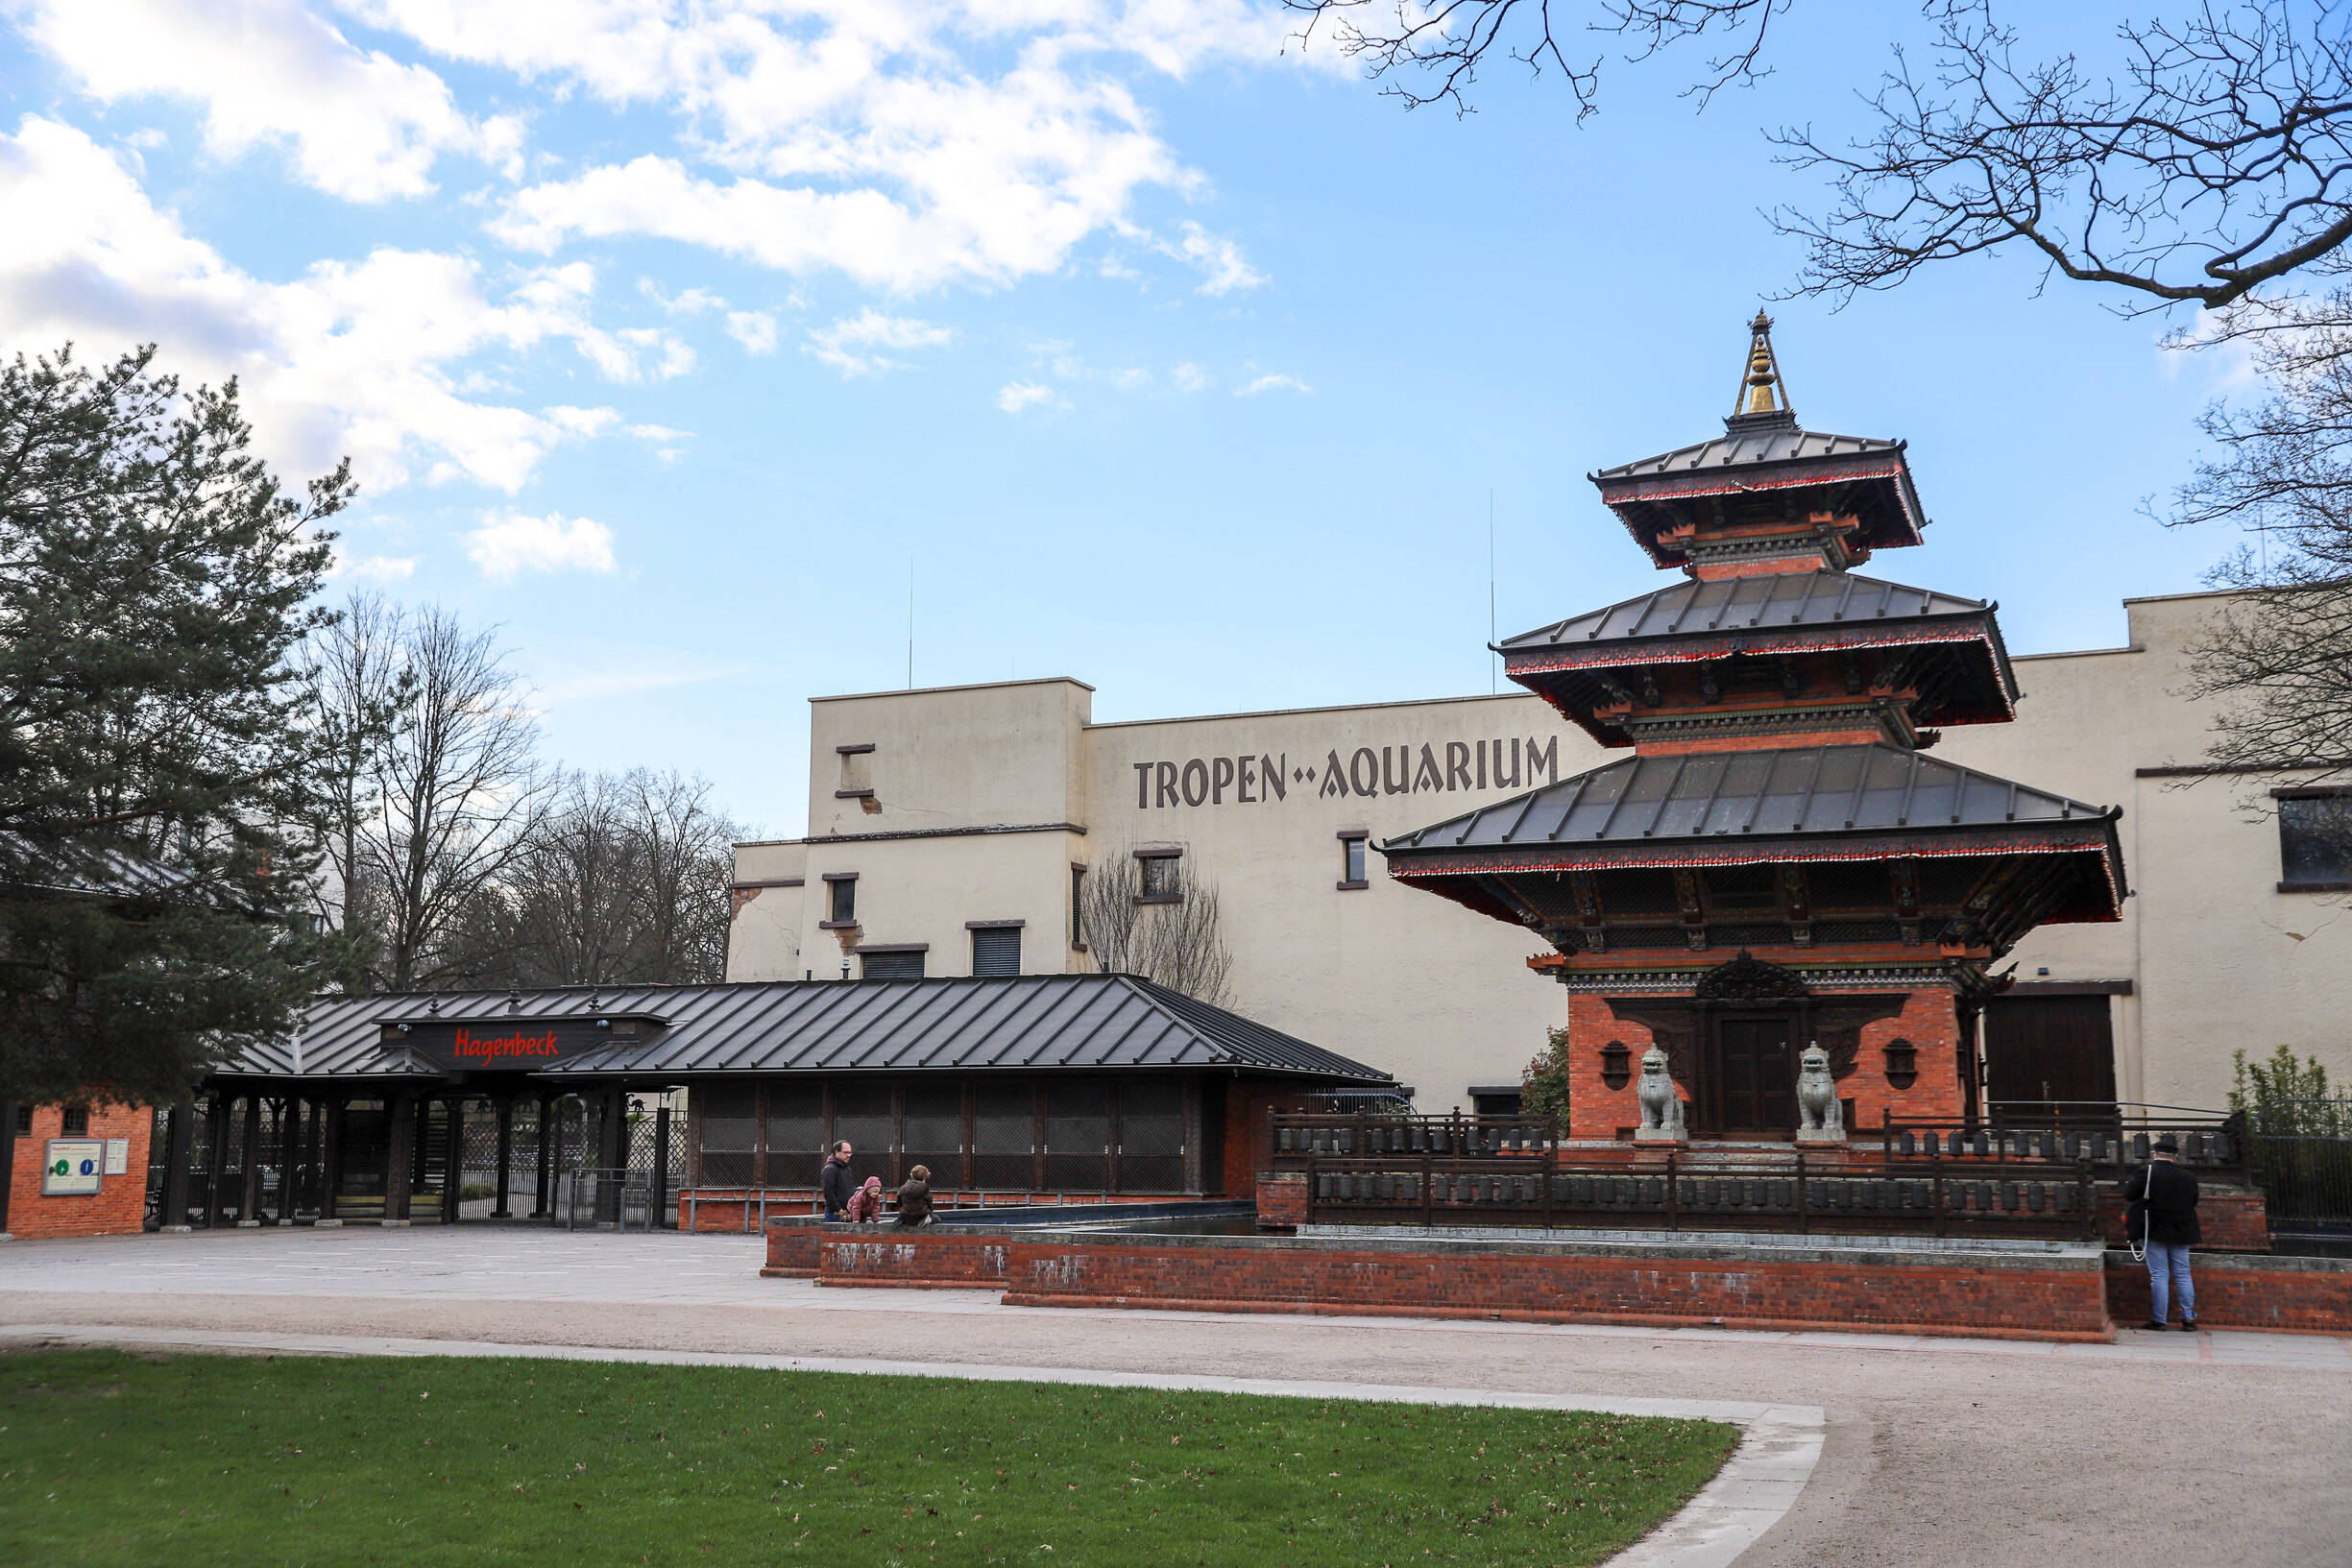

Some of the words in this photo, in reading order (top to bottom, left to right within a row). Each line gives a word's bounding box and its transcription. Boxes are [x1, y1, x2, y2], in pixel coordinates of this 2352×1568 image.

[1133, 752, 1287, 809] TROPEN
[1319, 735, 1559, 800] AQUARIUM
[454, 1028, 559, 1068] Hagenbeck
